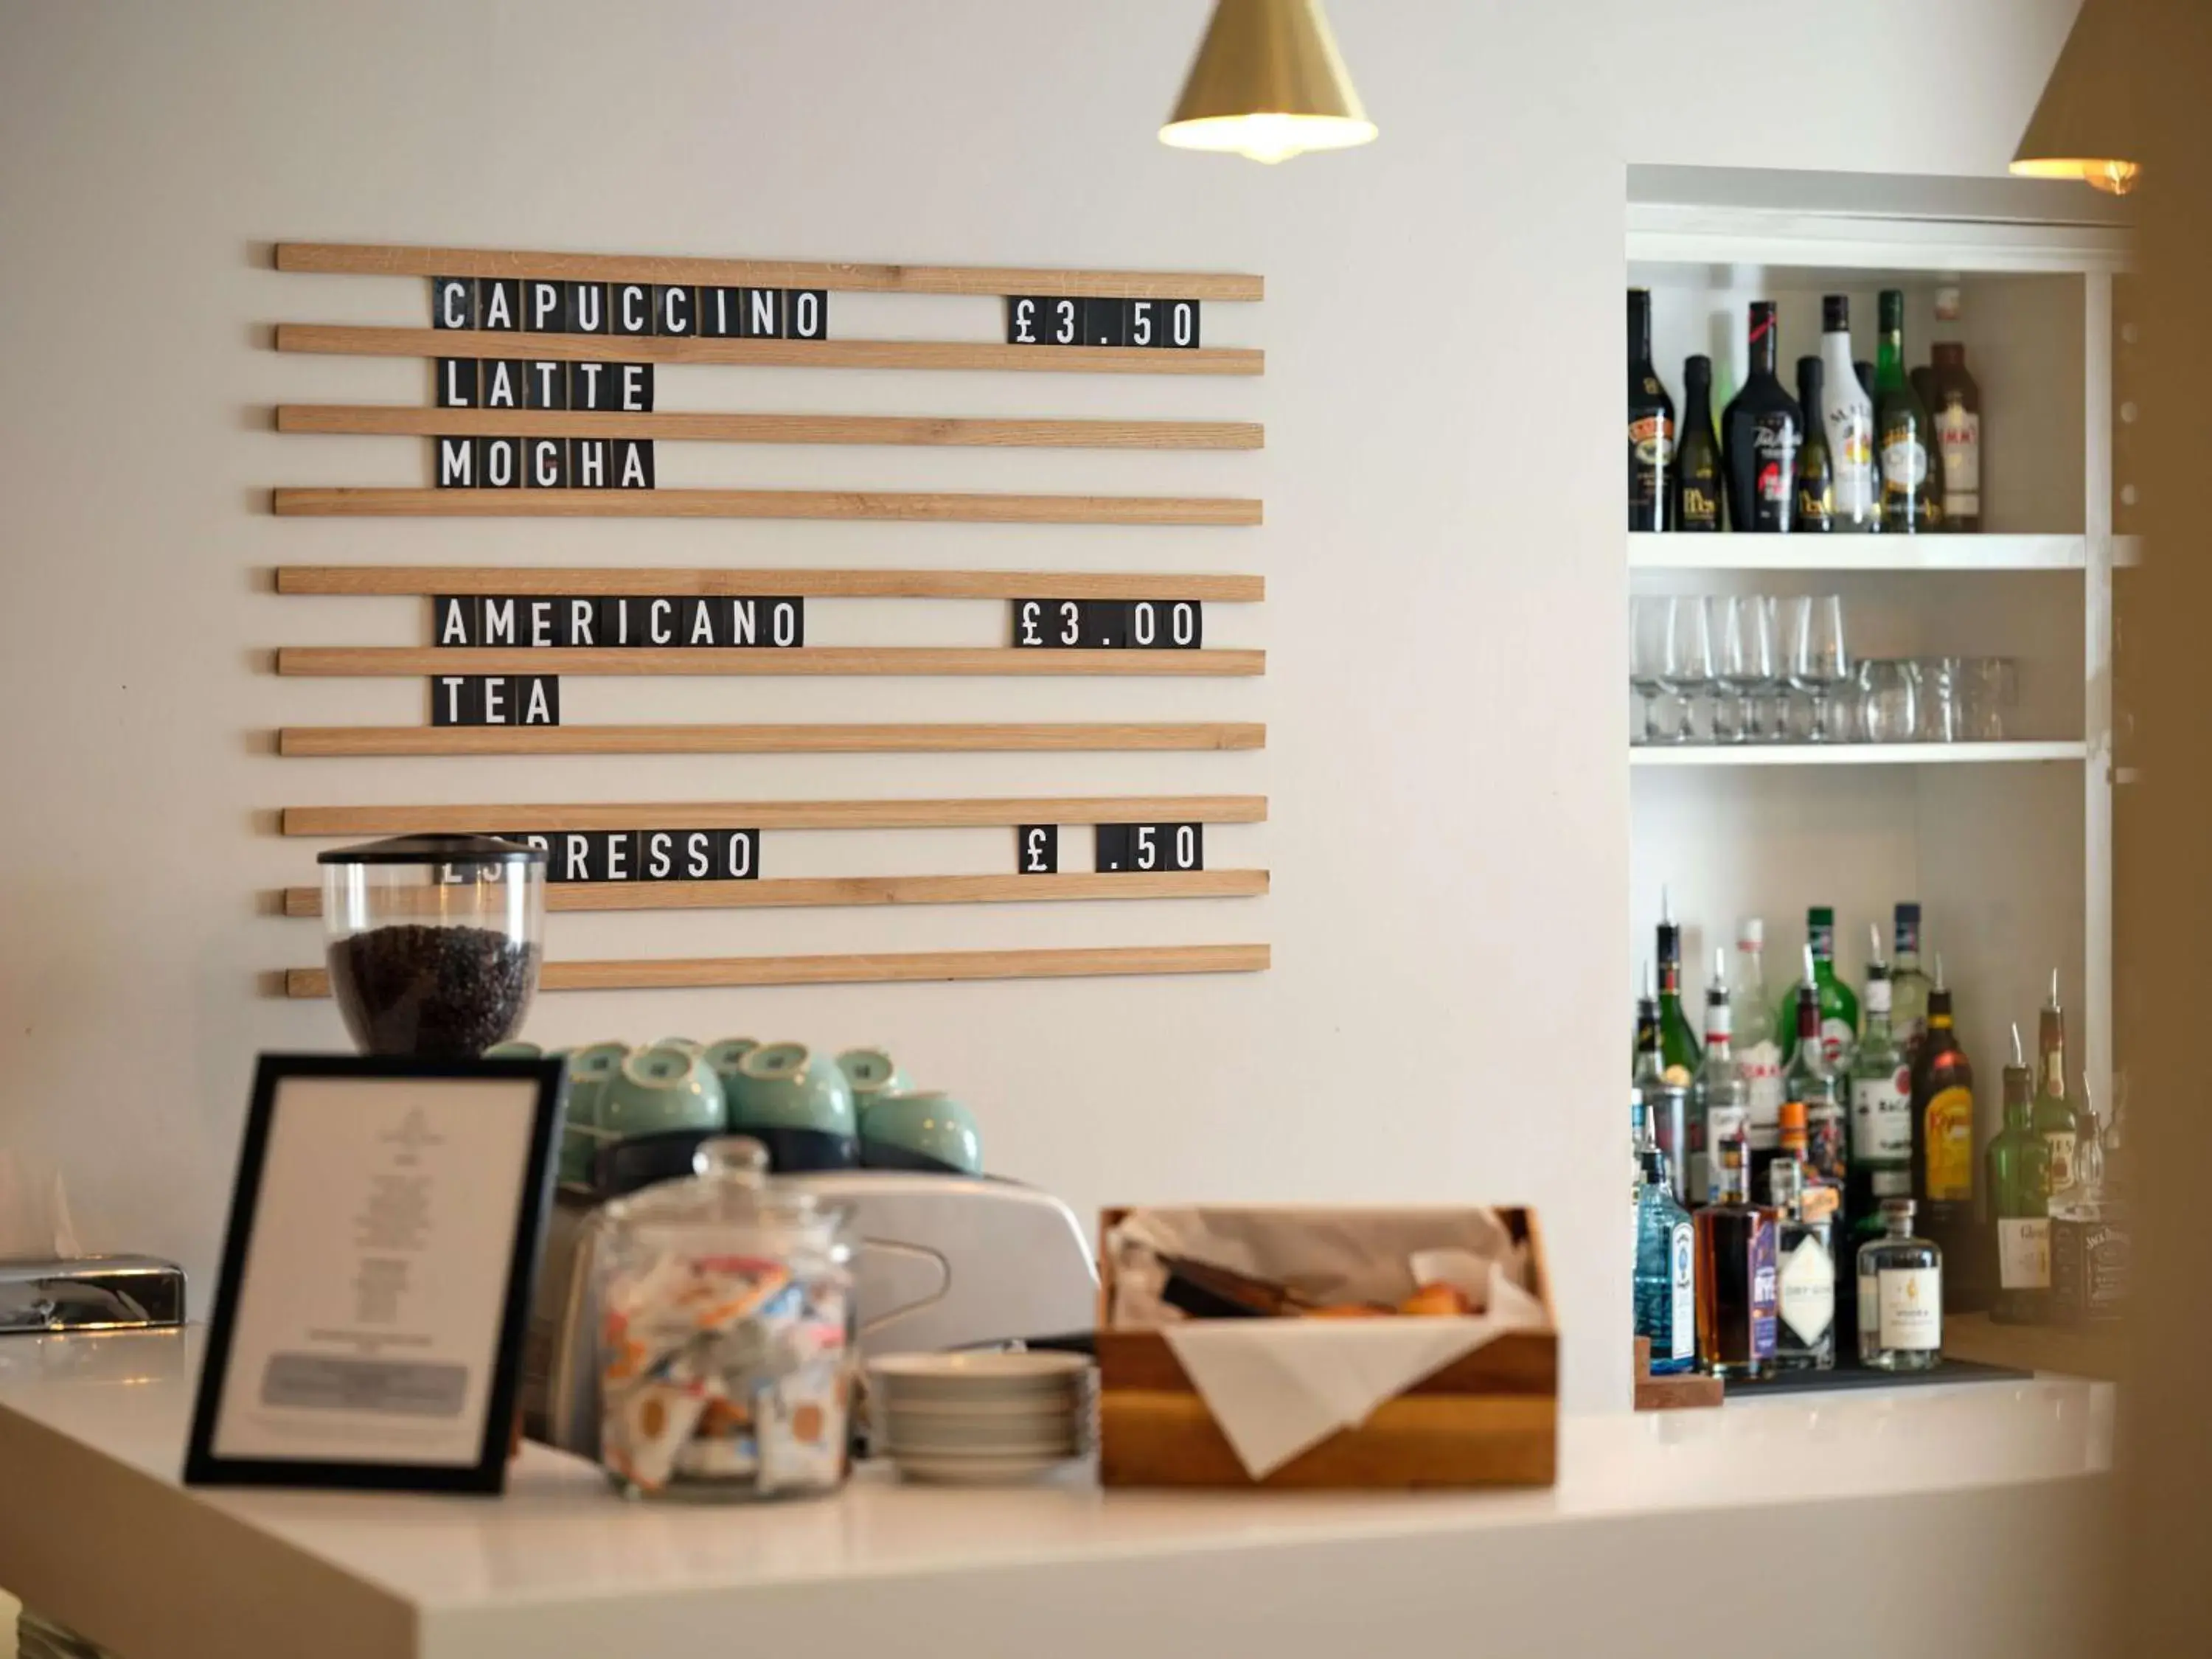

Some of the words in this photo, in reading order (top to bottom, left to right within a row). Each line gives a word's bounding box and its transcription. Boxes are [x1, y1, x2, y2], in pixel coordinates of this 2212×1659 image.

[444, 282, 818, 337] CAPUCCINO
[1016, 299, 1191, 346] £3.50
[448, 361, 643, 411] LATTE
[442, 440, 645, 487] MOCHA
[442, 599, 794, 647] AMERICANO
[1022, 602, 1193, 645] £3.00
[442, 678, 550, 723] TEA
[1027, 828, 1048, 872] £
[1110, 825, 1194, 869] .50
